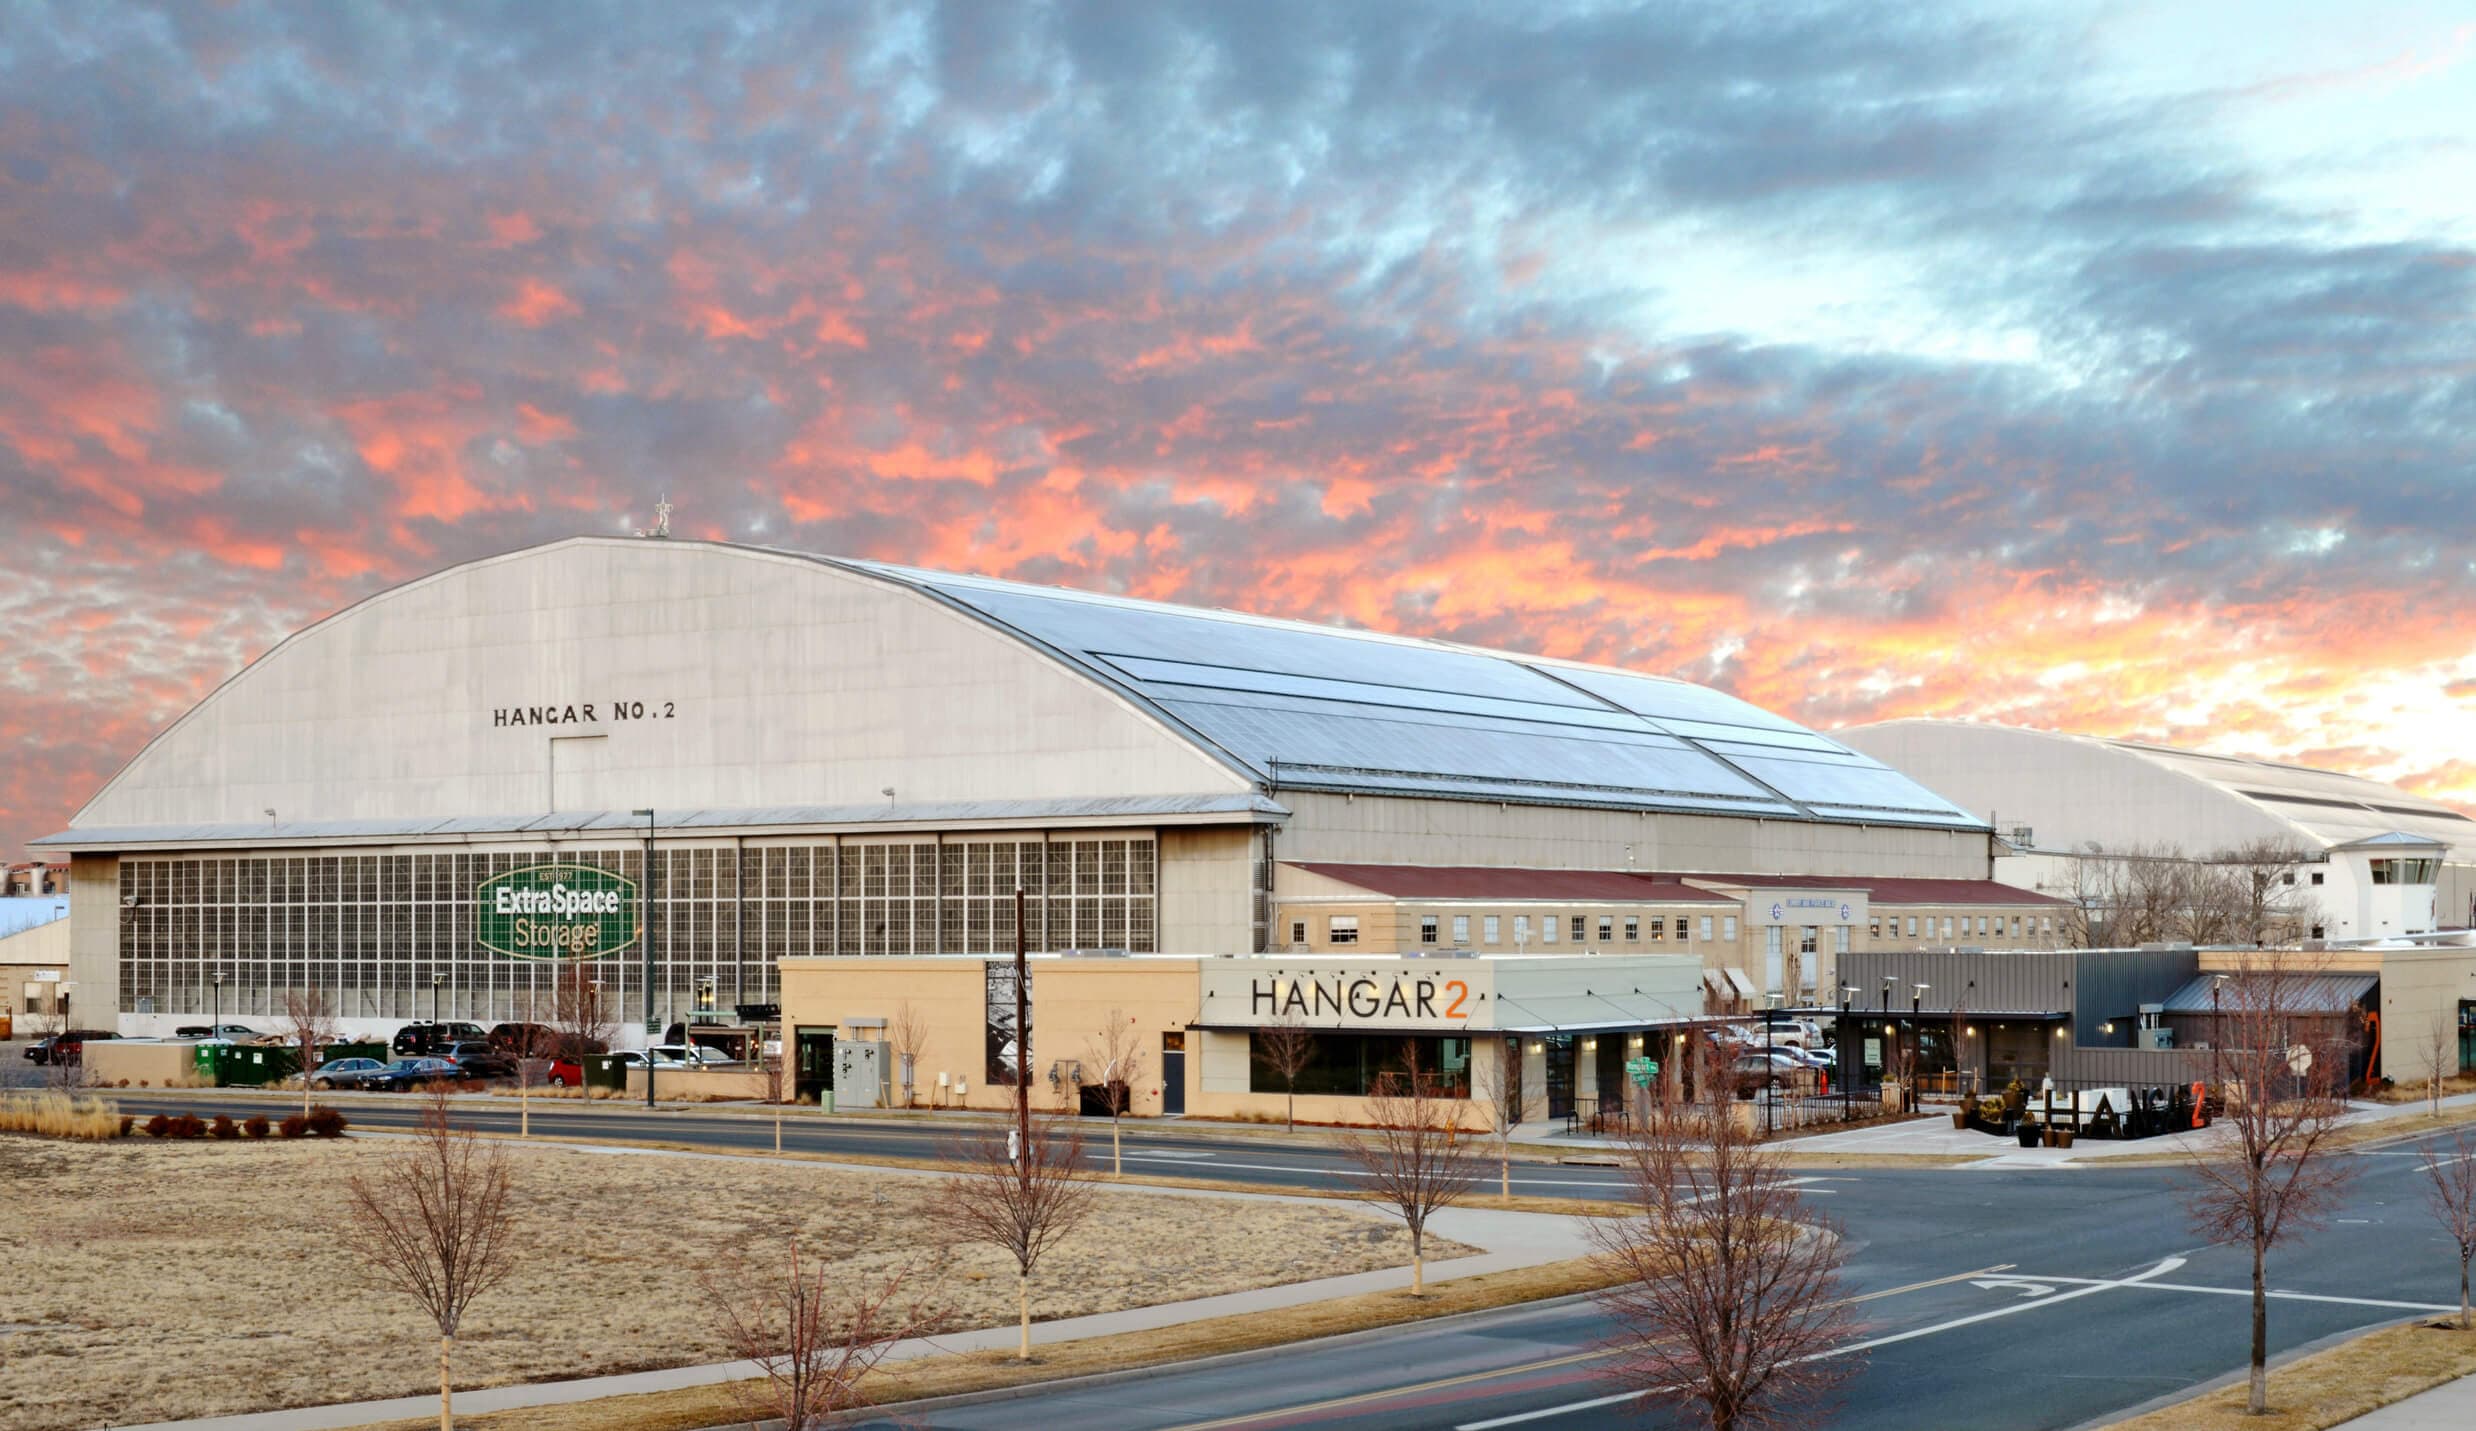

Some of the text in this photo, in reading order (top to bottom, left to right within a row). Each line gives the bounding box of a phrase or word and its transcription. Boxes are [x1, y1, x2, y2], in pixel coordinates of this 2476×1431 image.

[494, 704, 598, 727] HANGAR
[515, 918, 598, 952] Storage
[1252, 979, 1468, 1018] HANGAR 2
